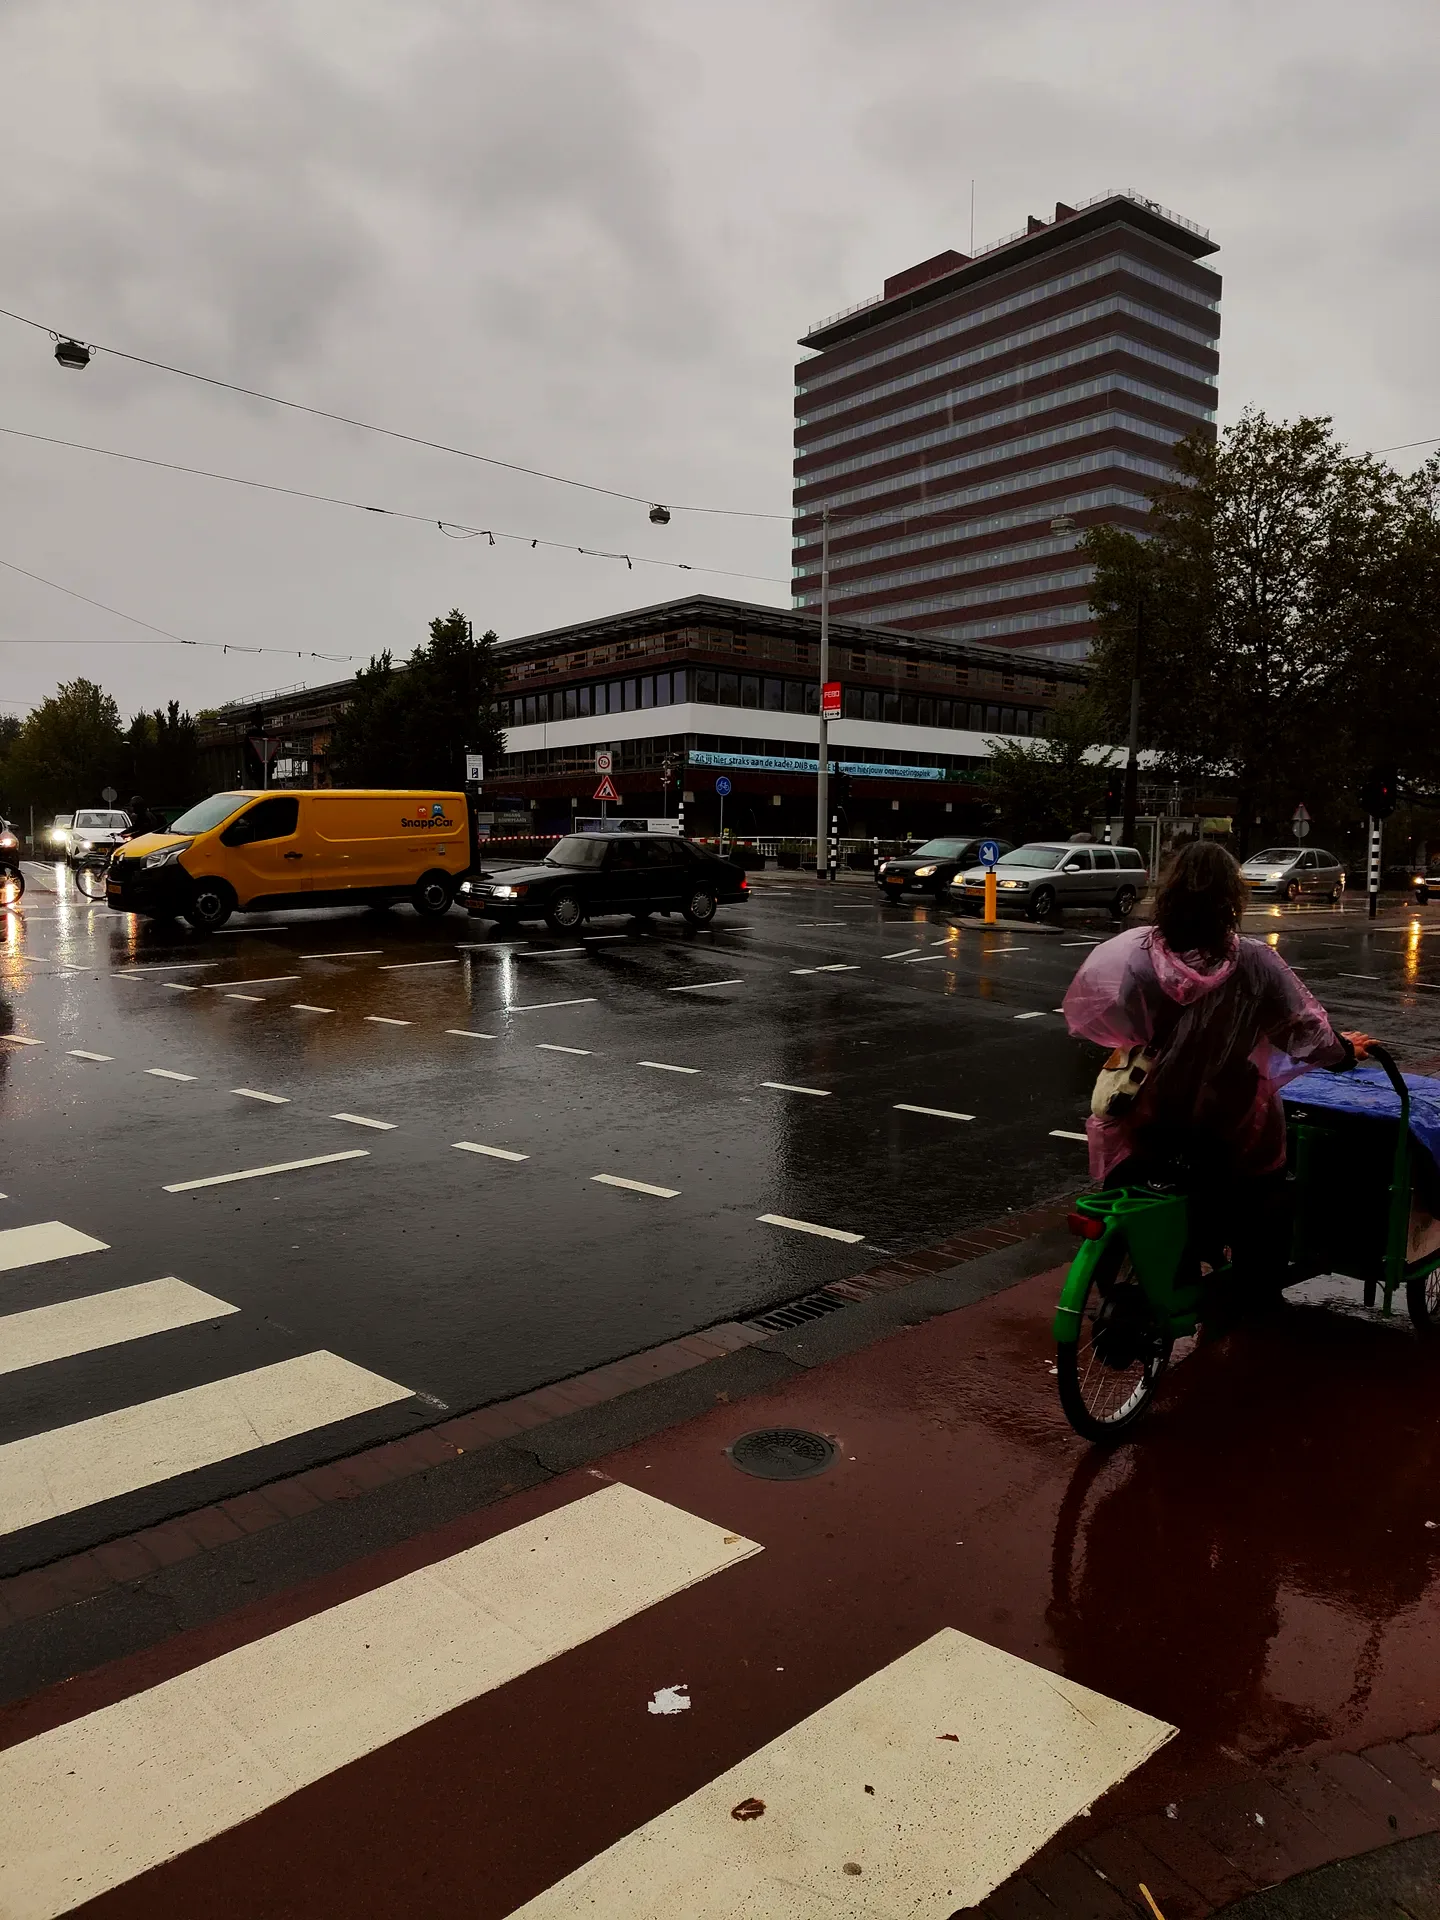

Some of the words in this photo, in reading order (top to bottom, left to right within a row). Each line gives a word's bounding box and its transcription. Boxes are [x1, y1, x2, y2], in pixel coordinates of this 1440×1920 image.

[824, 690, 840, 698] FEBO
[695, 753, 705, 763] Zit
[713, 755, 727, 764] hier
[729, 757, 749, 766] straks
[765, 759, 773, 767] de
[775, 759, 792, 768] kade?
[832, 763, 856, 773] buwen
[857, 765, 869, 774] hier
[869, 766, 884, 775] jouw
[401, 817, 453, 829] SnappCar
